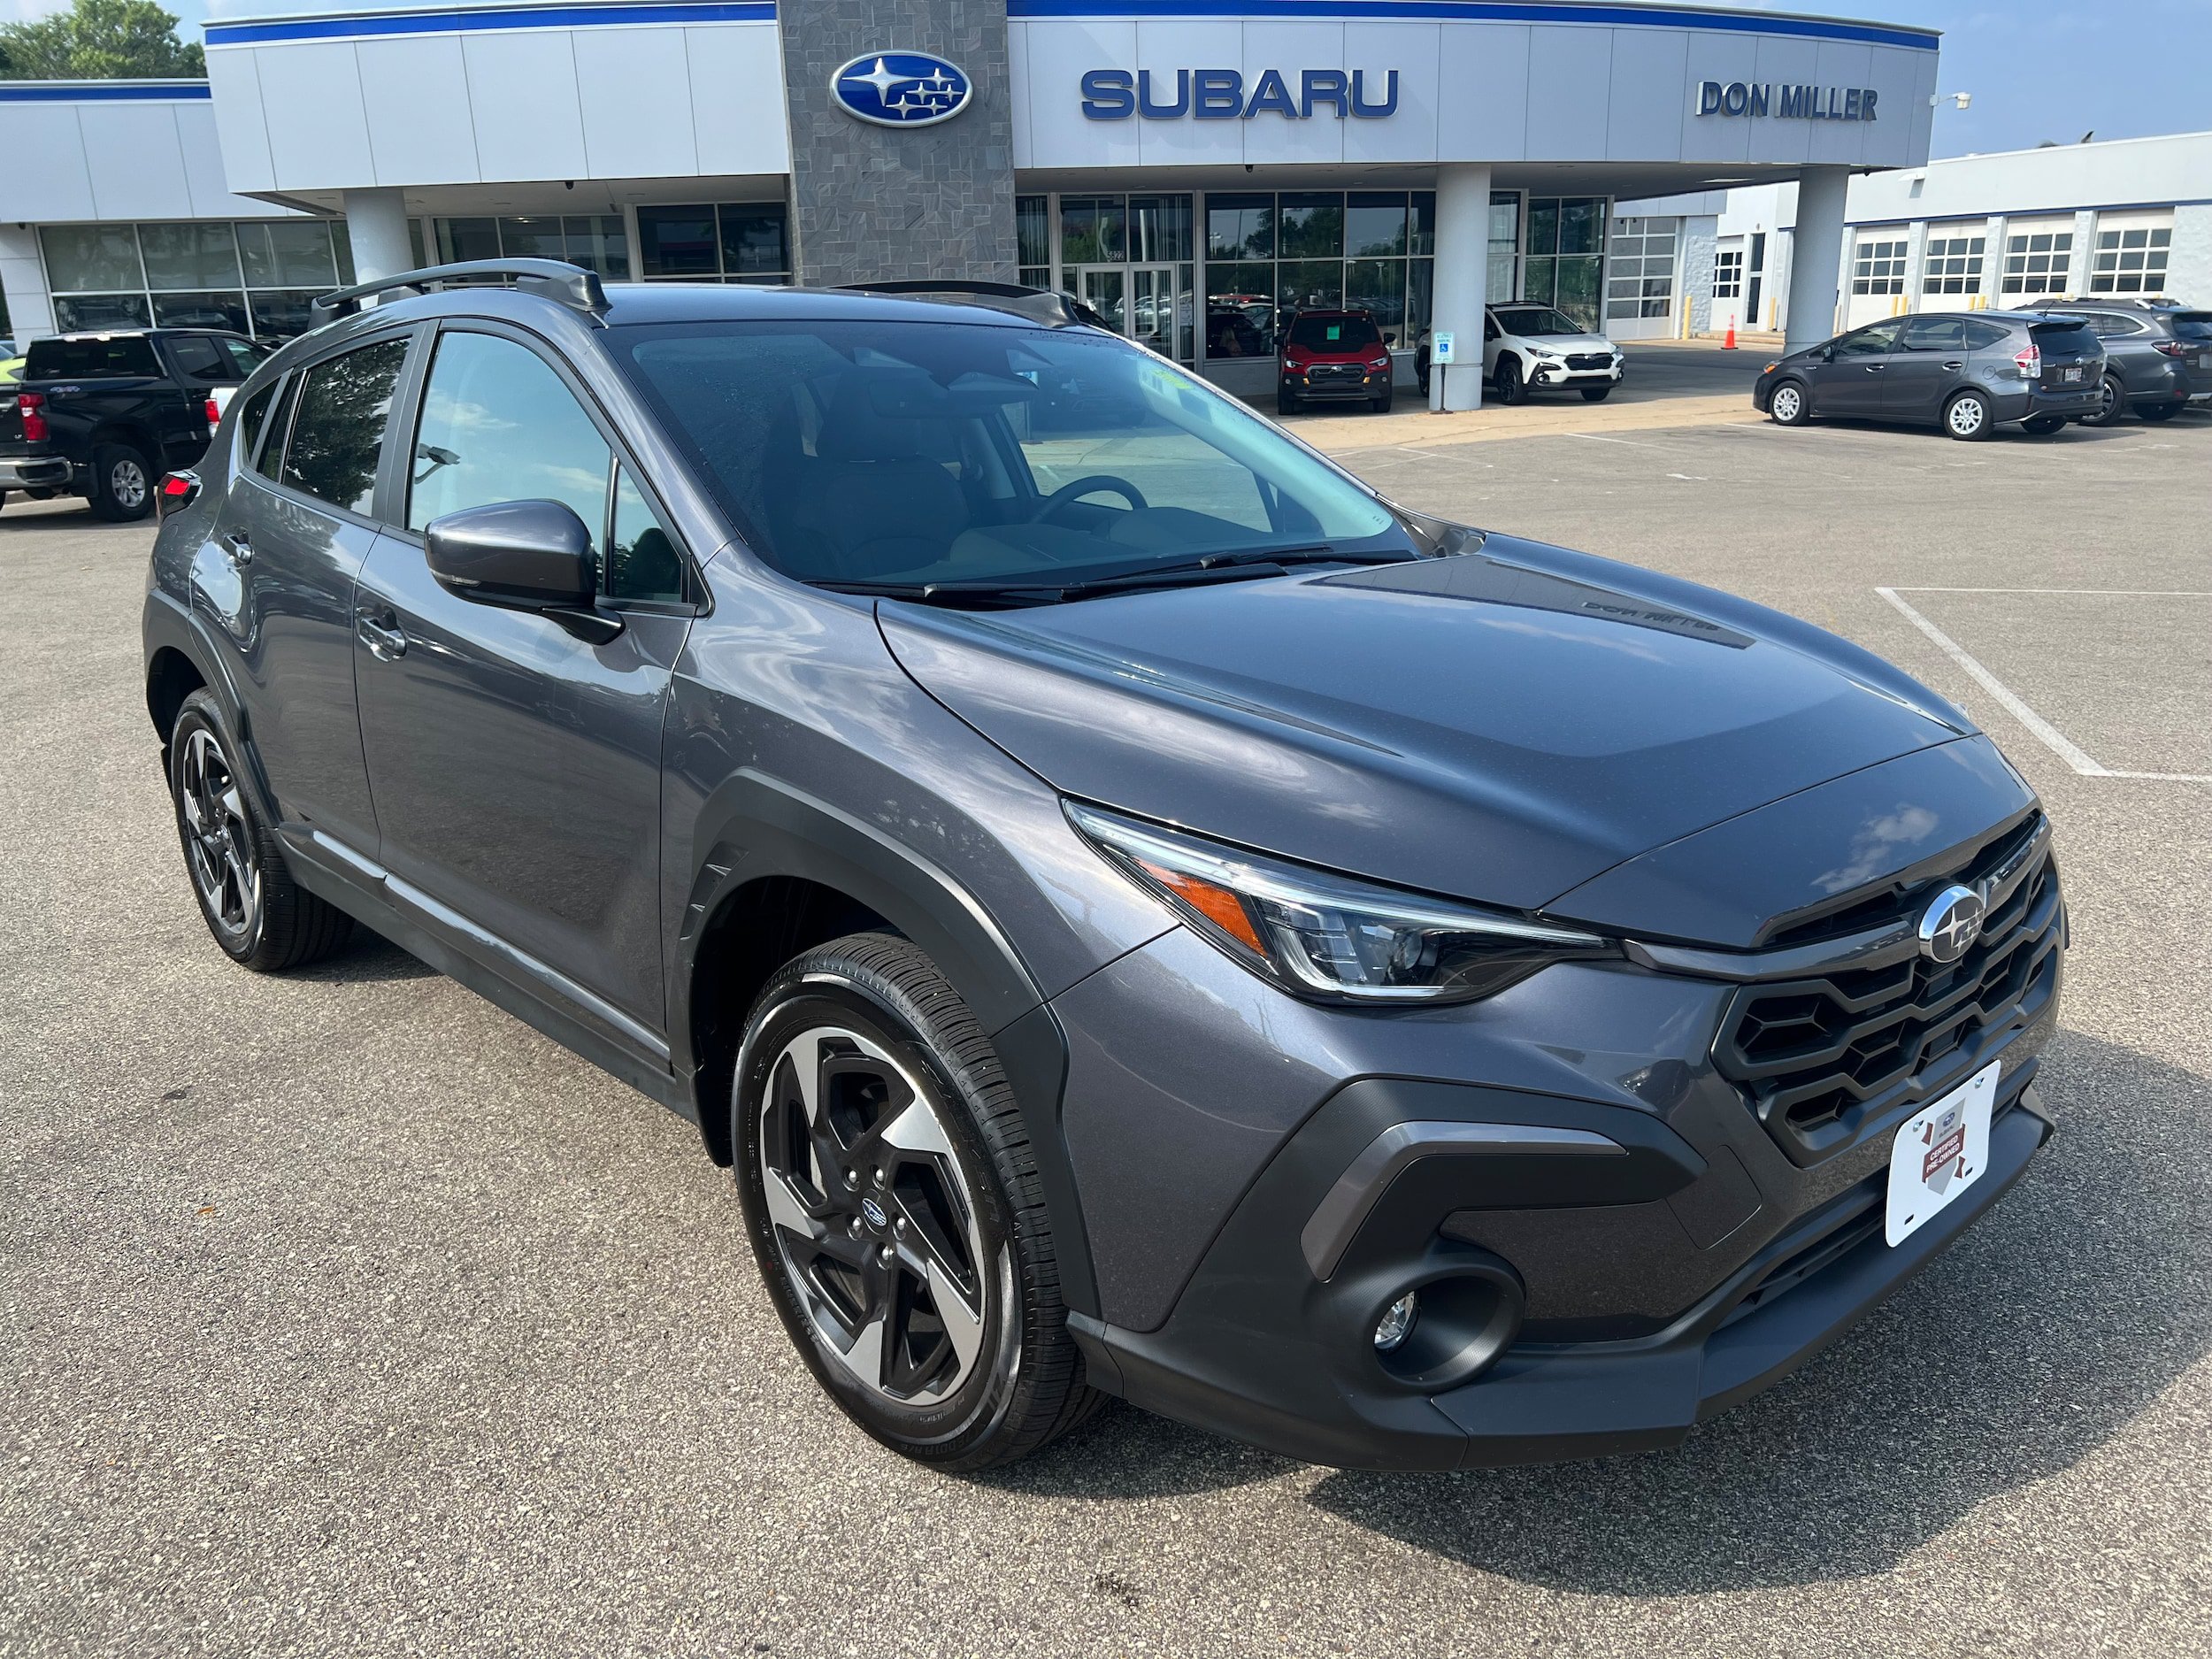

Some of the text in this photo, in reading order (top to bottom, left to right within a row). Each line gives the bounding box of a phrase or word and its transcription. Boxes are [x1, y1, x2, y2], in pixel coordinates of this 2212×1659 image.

[1080, 69, 1399, 119] SUBARU
[1695, 81, 1878, 121] DON MILLER
[1925, 1142, 1960, 1173] PRE-OWNED
[1930, 1134, 1958, 1161] CERTIFIED
